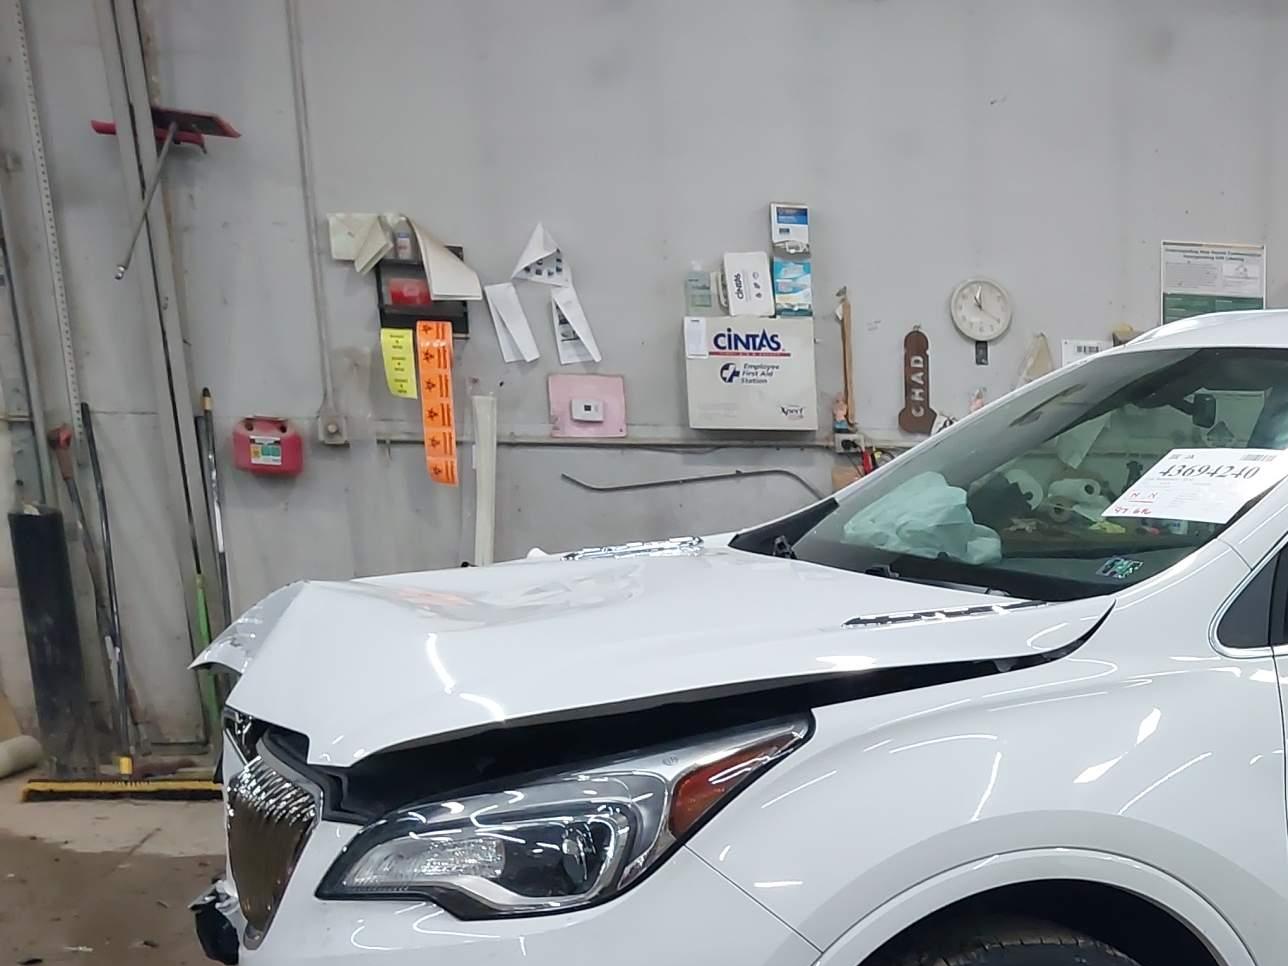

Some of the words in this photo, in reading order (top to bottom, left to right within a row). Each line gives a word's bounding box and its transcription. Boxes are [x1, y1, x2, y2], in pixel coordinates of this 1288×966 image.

[743, 363, 780, 372] Employee
[911, 355, 925, 417] CHAD
[1159, 464, 1261, 480] 43694240
